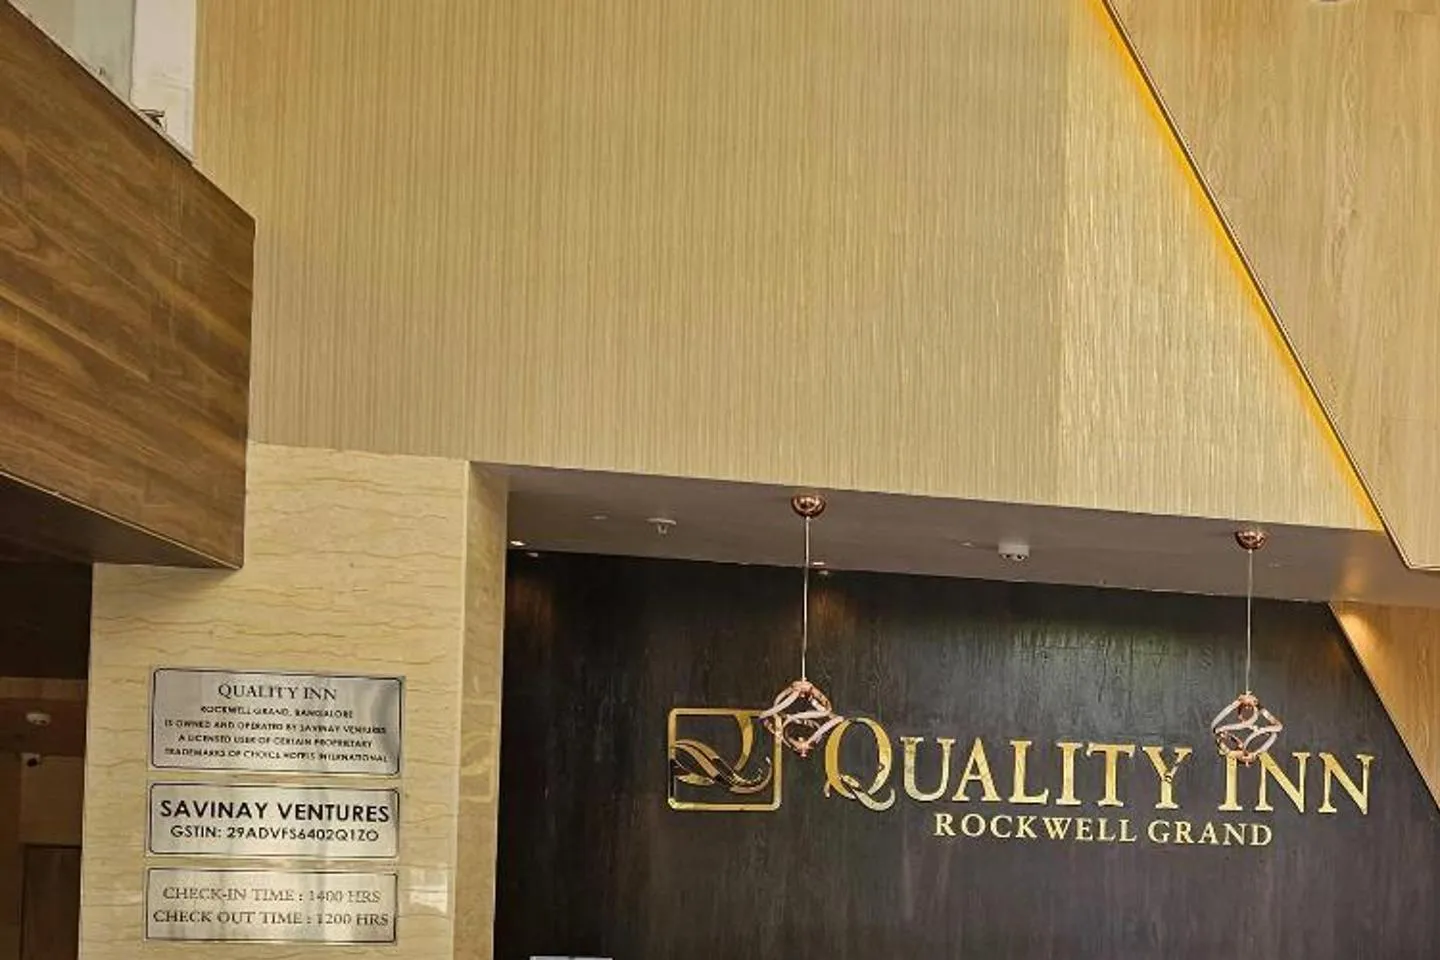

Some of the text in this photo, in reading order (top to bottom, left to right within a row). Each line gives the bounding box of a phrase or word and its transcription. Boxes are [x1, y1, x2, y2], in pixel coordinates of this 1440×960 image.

[217, 684, 337, 700] QUALITY INN
[213, 721, 235, 730] AND
[824, 717, 1375, 815] QUALITY INN
[160, 800, 390, 823] SAVINAY VENTURES
[170, 825, 222, 839] GSTIN:
[933, 812, 1274, 847] ROCKWELL GRAND
[162, 886, 247, 901] CHECK-IN
[252, 887, 295, 902] TIME
[347, 890, 382, 903] HRS
[153, 909, 213, 923] CHECK
[216, 911, 257, 925] OUT
[258, 911, 303, 925] TIME
[315, 913, 352, 925] 1200
[356, 913, 390, 927] HRS
